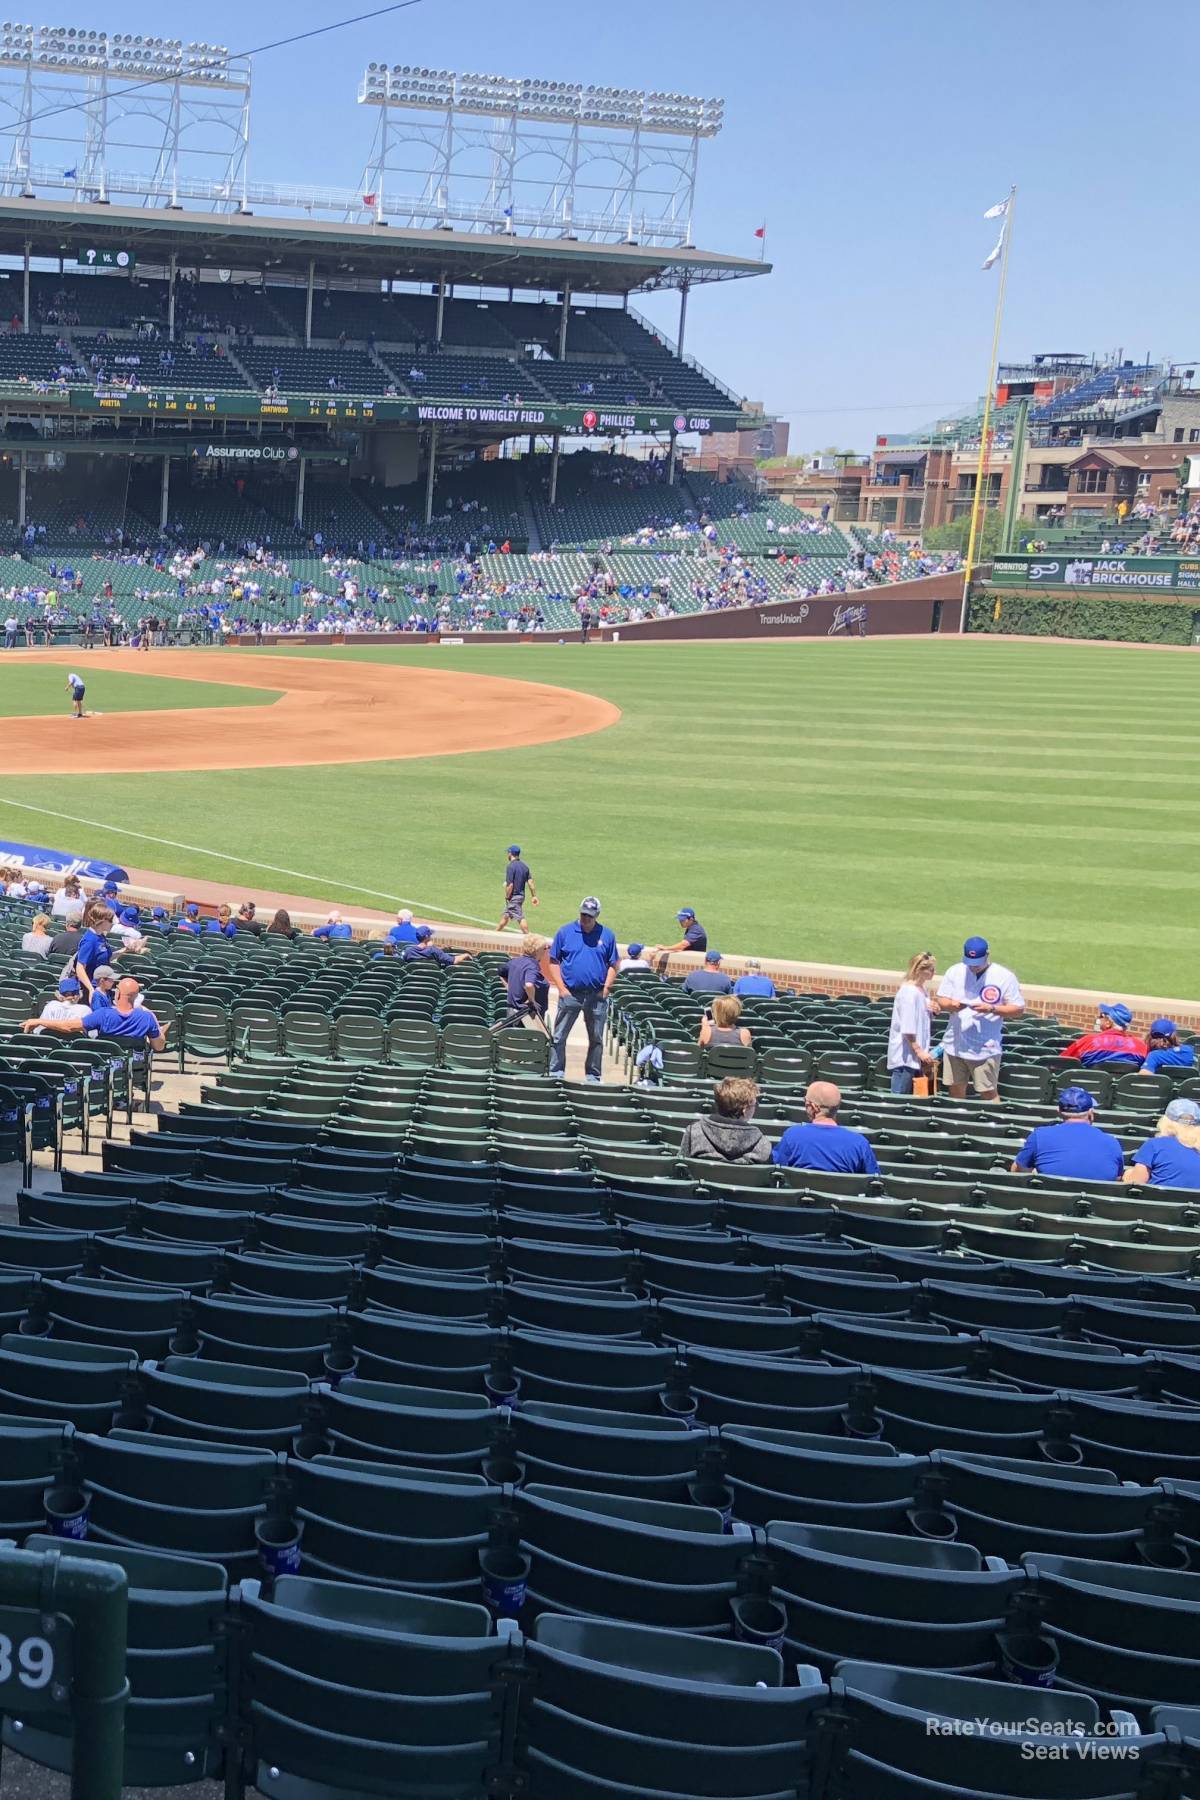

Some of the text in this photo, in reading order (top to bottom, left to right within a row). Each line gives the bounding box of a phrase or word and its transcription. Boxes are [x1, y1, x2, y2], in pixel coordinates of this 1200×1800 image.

[418, 406, 545, 423] WELCOME TO WRIGLEY FIELD
[600, 414, 636, 427] PHILLIES
[689, 417, 711, 430] CUBS
[205, 445, 286, 459] Assurance Club
[1094, 560, 1127, 571] JACK
[1092, 573, 1173, 586] BRICKHOUSE
[1177, 580, 1197, 588] HALL
[759, 613, 802, 625] TransUnion
